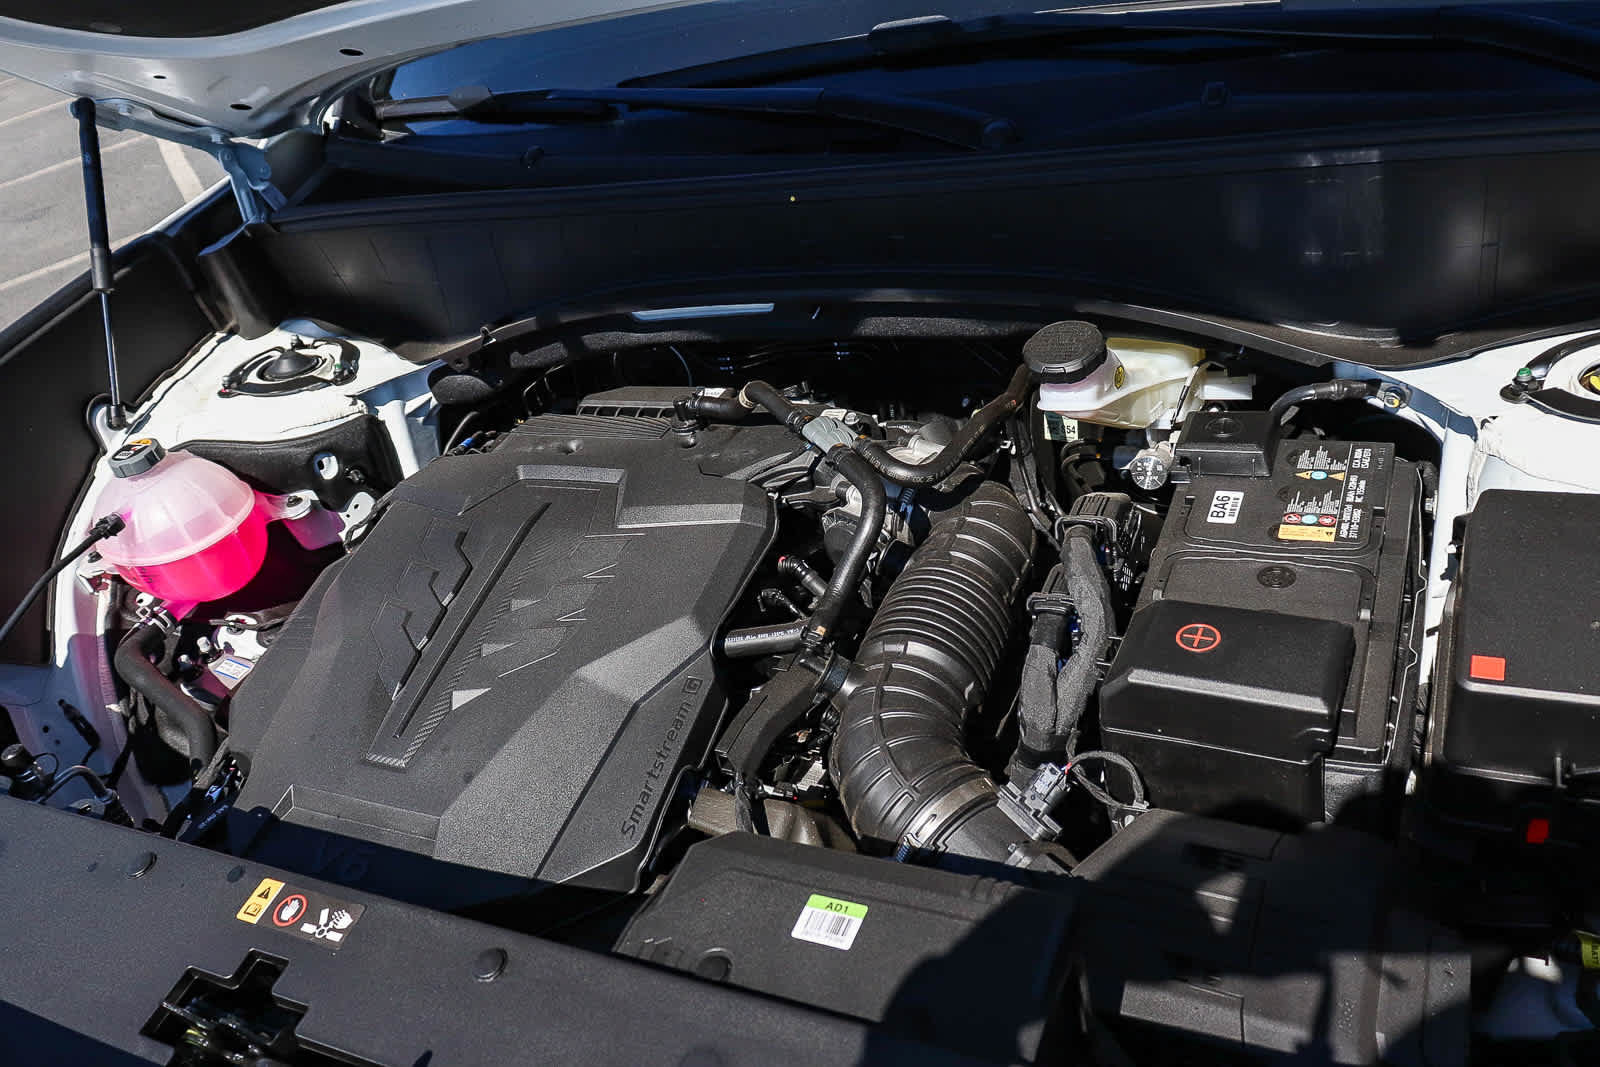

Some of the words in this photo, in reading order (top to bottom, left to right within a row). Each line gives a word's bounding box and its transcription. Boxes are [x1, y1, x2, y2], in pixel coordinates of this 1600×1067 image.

[1210, 495, 1231, 518] BA6
[621, 701, 693, 840] Smartstream
[824, 902, 849, 913] AD1
